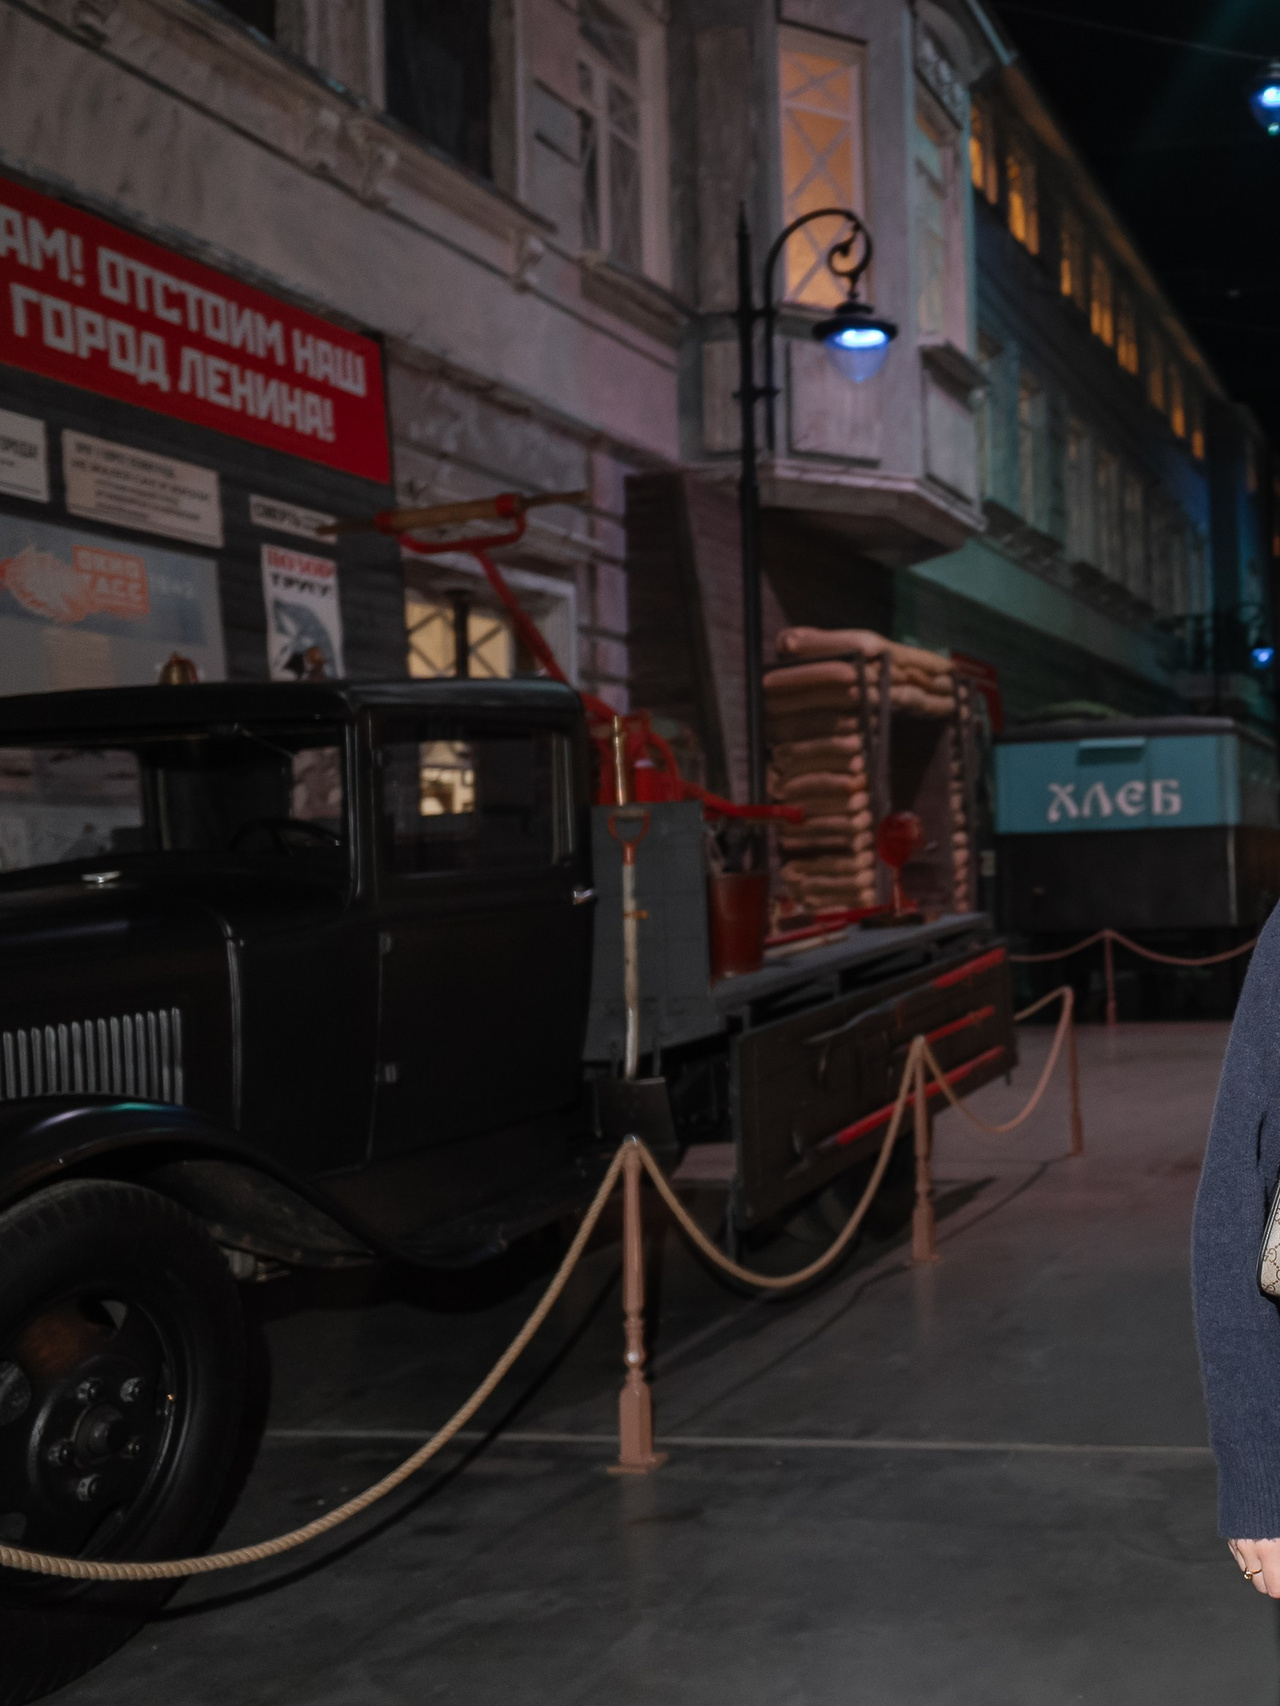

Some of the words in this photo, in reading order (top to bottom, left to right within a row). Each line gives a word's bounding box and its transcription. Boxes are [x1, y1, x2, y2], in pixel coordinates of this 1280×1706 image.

[10, 282, 172, 394] ГОРОД
[179, 346, 337, 443] ЛЕНИНА!
[98, 246, 288, 367] ОТСТОИМ
[291, 331, 368, 397] НАШ
[1047, 779, 1183, 824] ХЛЕБ
